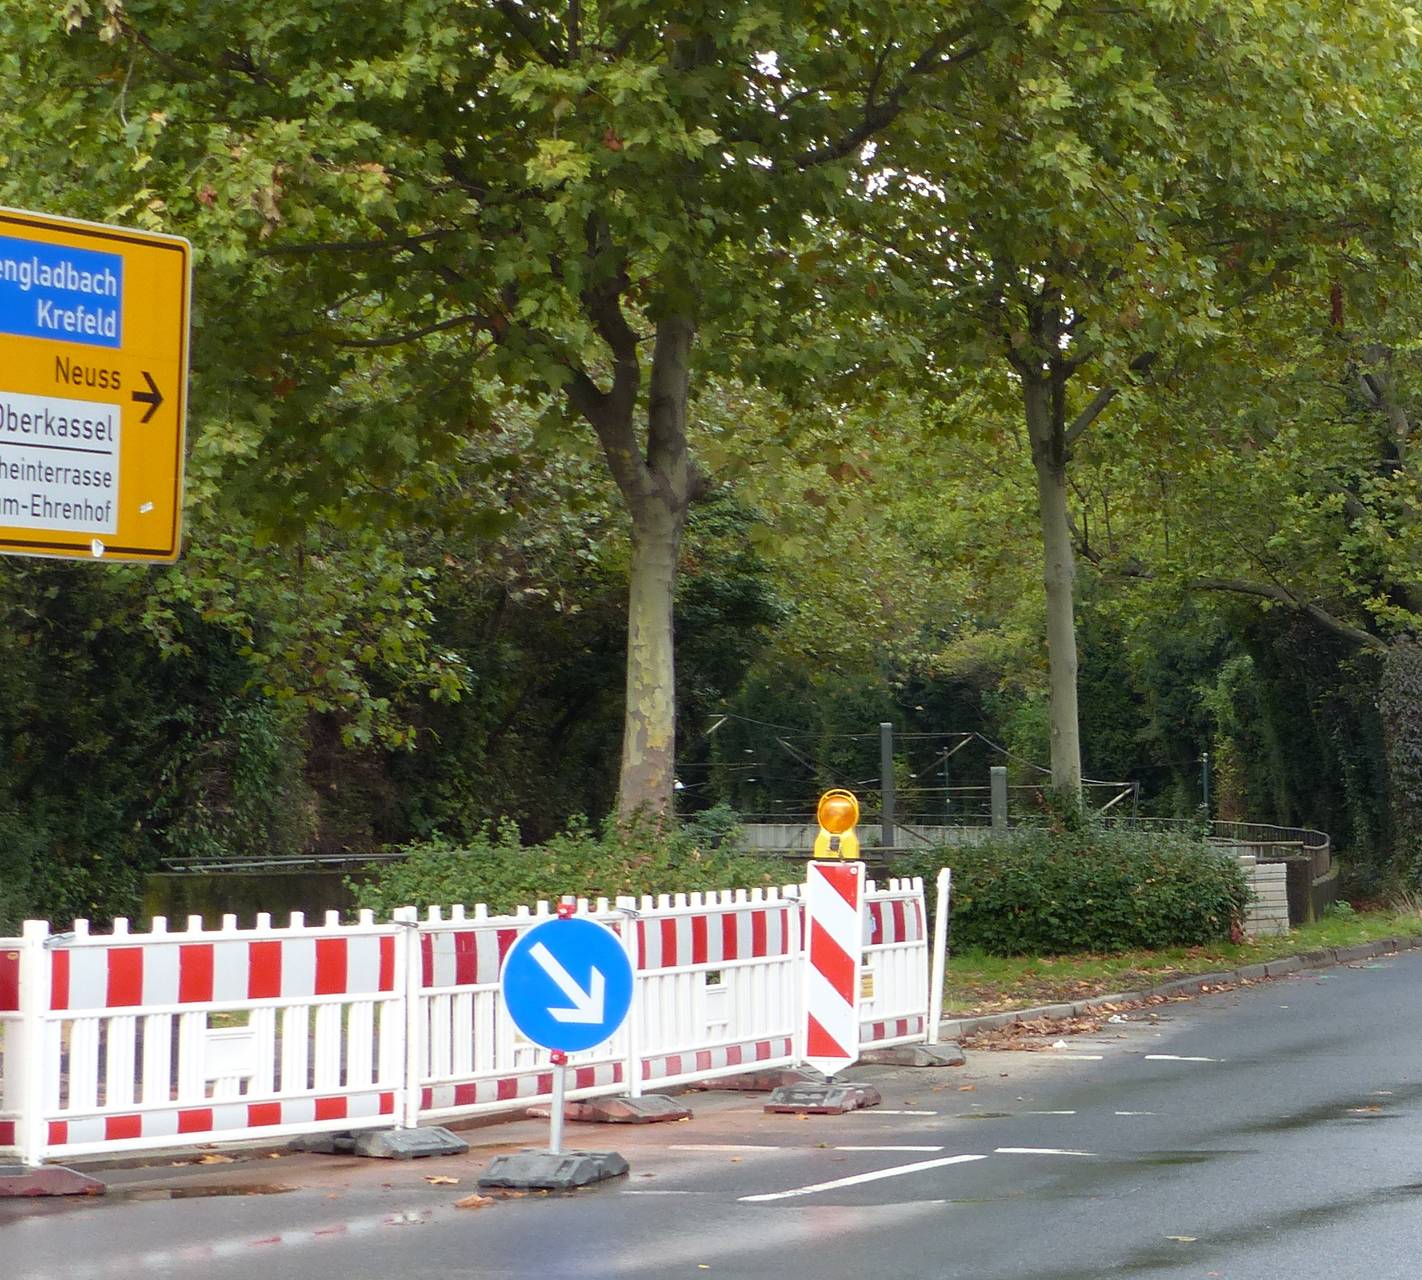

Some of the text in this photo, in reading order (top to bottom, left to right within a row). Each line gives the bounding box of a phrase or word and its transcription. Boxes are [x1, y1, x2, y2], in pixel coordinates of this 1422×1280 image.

[0, 256, 117, 297] ngladbach
[37, 298, 117, 338] Krefeld
[55, 355, 121, 390] Neuss
[0, 494, 112, 523] m-Ehrenhof
